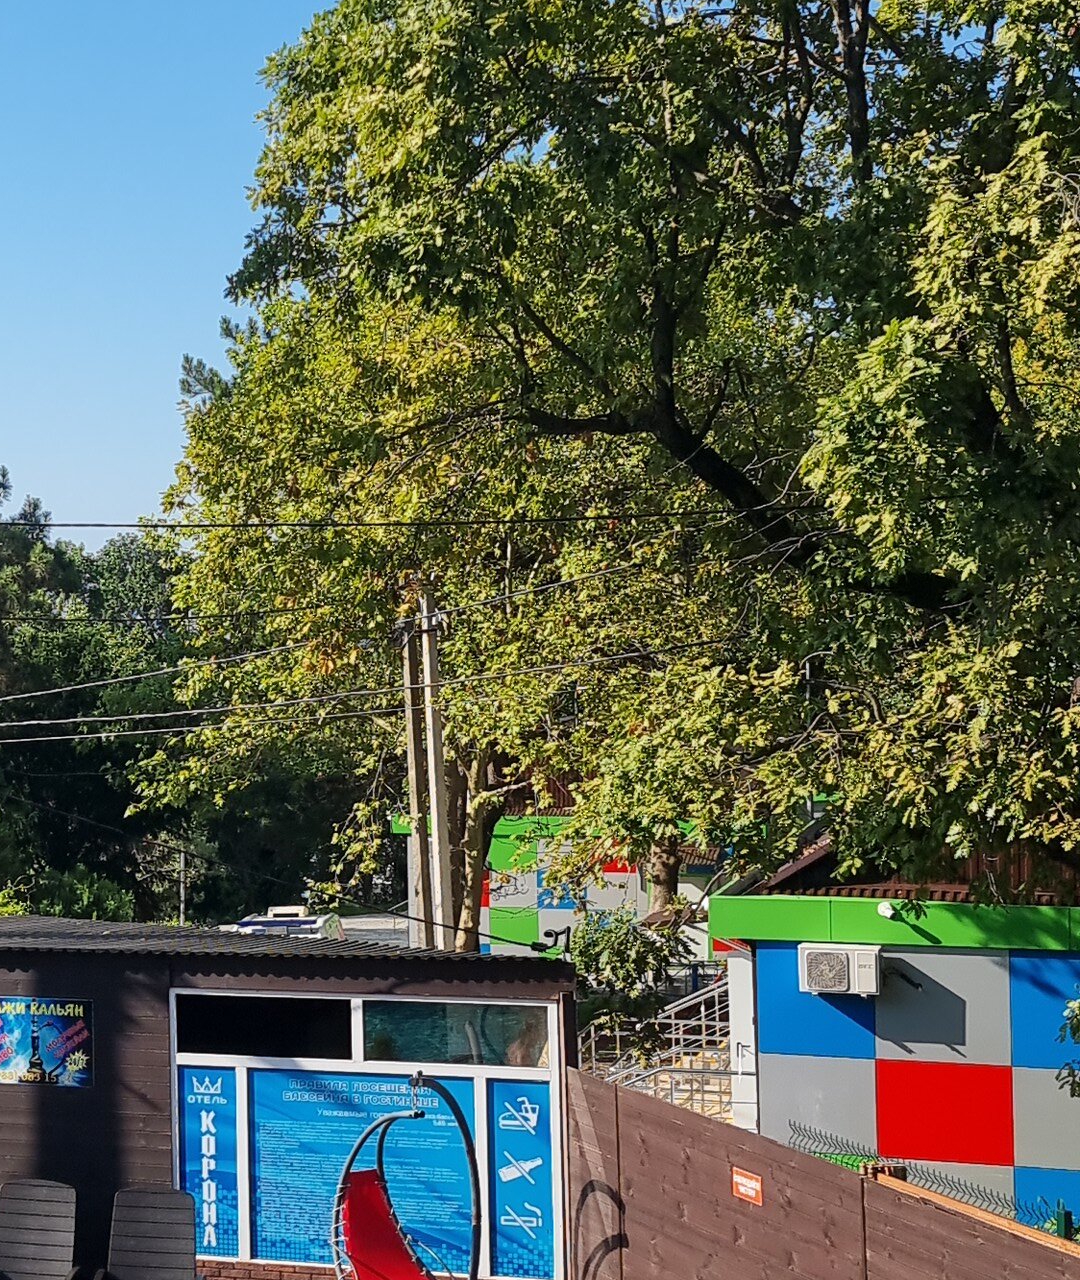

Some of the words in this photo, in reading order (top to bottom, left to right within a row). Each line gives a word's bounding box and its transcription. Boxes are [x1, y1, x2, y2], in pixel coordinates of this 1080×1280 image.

[30, 1001, 84, 1017] КАЛЬЯН
[289, 1079, 349, 1092] ПРАВИЛА
[187, 1095, 228, 1105] ОТЕЛЬ
[283, 1090, 349, 1103] БАССЕЙНА
[352, 1094, 361, 1104] В
[200, 1109, 217, 1248] КОРОНА
